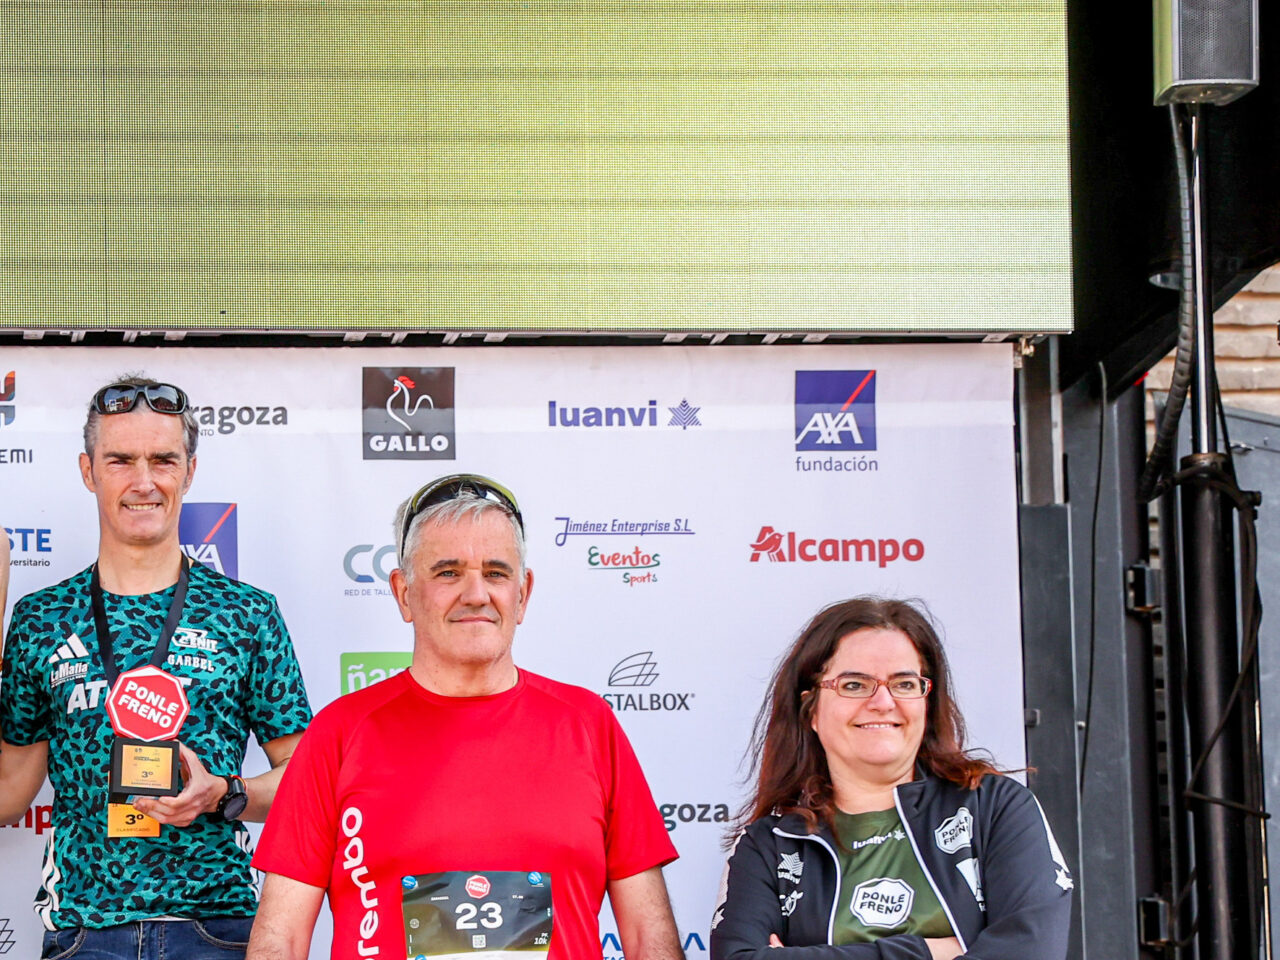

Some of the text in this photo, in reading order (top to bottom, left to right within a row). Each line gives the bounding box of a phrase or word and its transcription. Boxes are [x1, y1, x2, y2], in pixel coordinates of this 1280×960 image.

[194, 404, 288, 435] agoza
[548, 400, 657, 427] luanvi
[795, 412, 863, 444] AXA
[369, 434, 449, 452] GALLO
[795, 456, 878, 472] fundación
[8, 528, 53, 553] STE
[555, 517, 671, 547] Jiménez Enterprise
[588, 546, 661, 567] Eventos
[749, 526, 926, 569] Alcampo
[9, 559, 51, 568] versitario
[622, 572, 658, 587] Sports
[344, 589, 358, 597] RED
[360, 589, 371, 597] DE
[167, 654, 215, 672] GARBEL
[125, 681, 179, 717] PONLE
[118, 696, 172, 729] FRENO
[660, 803, 730, 832] goza
[859, 901, 903, 914] FRENO
[862, 891, 906, 905] PONLE
[455, 902, 504, 930] 23
